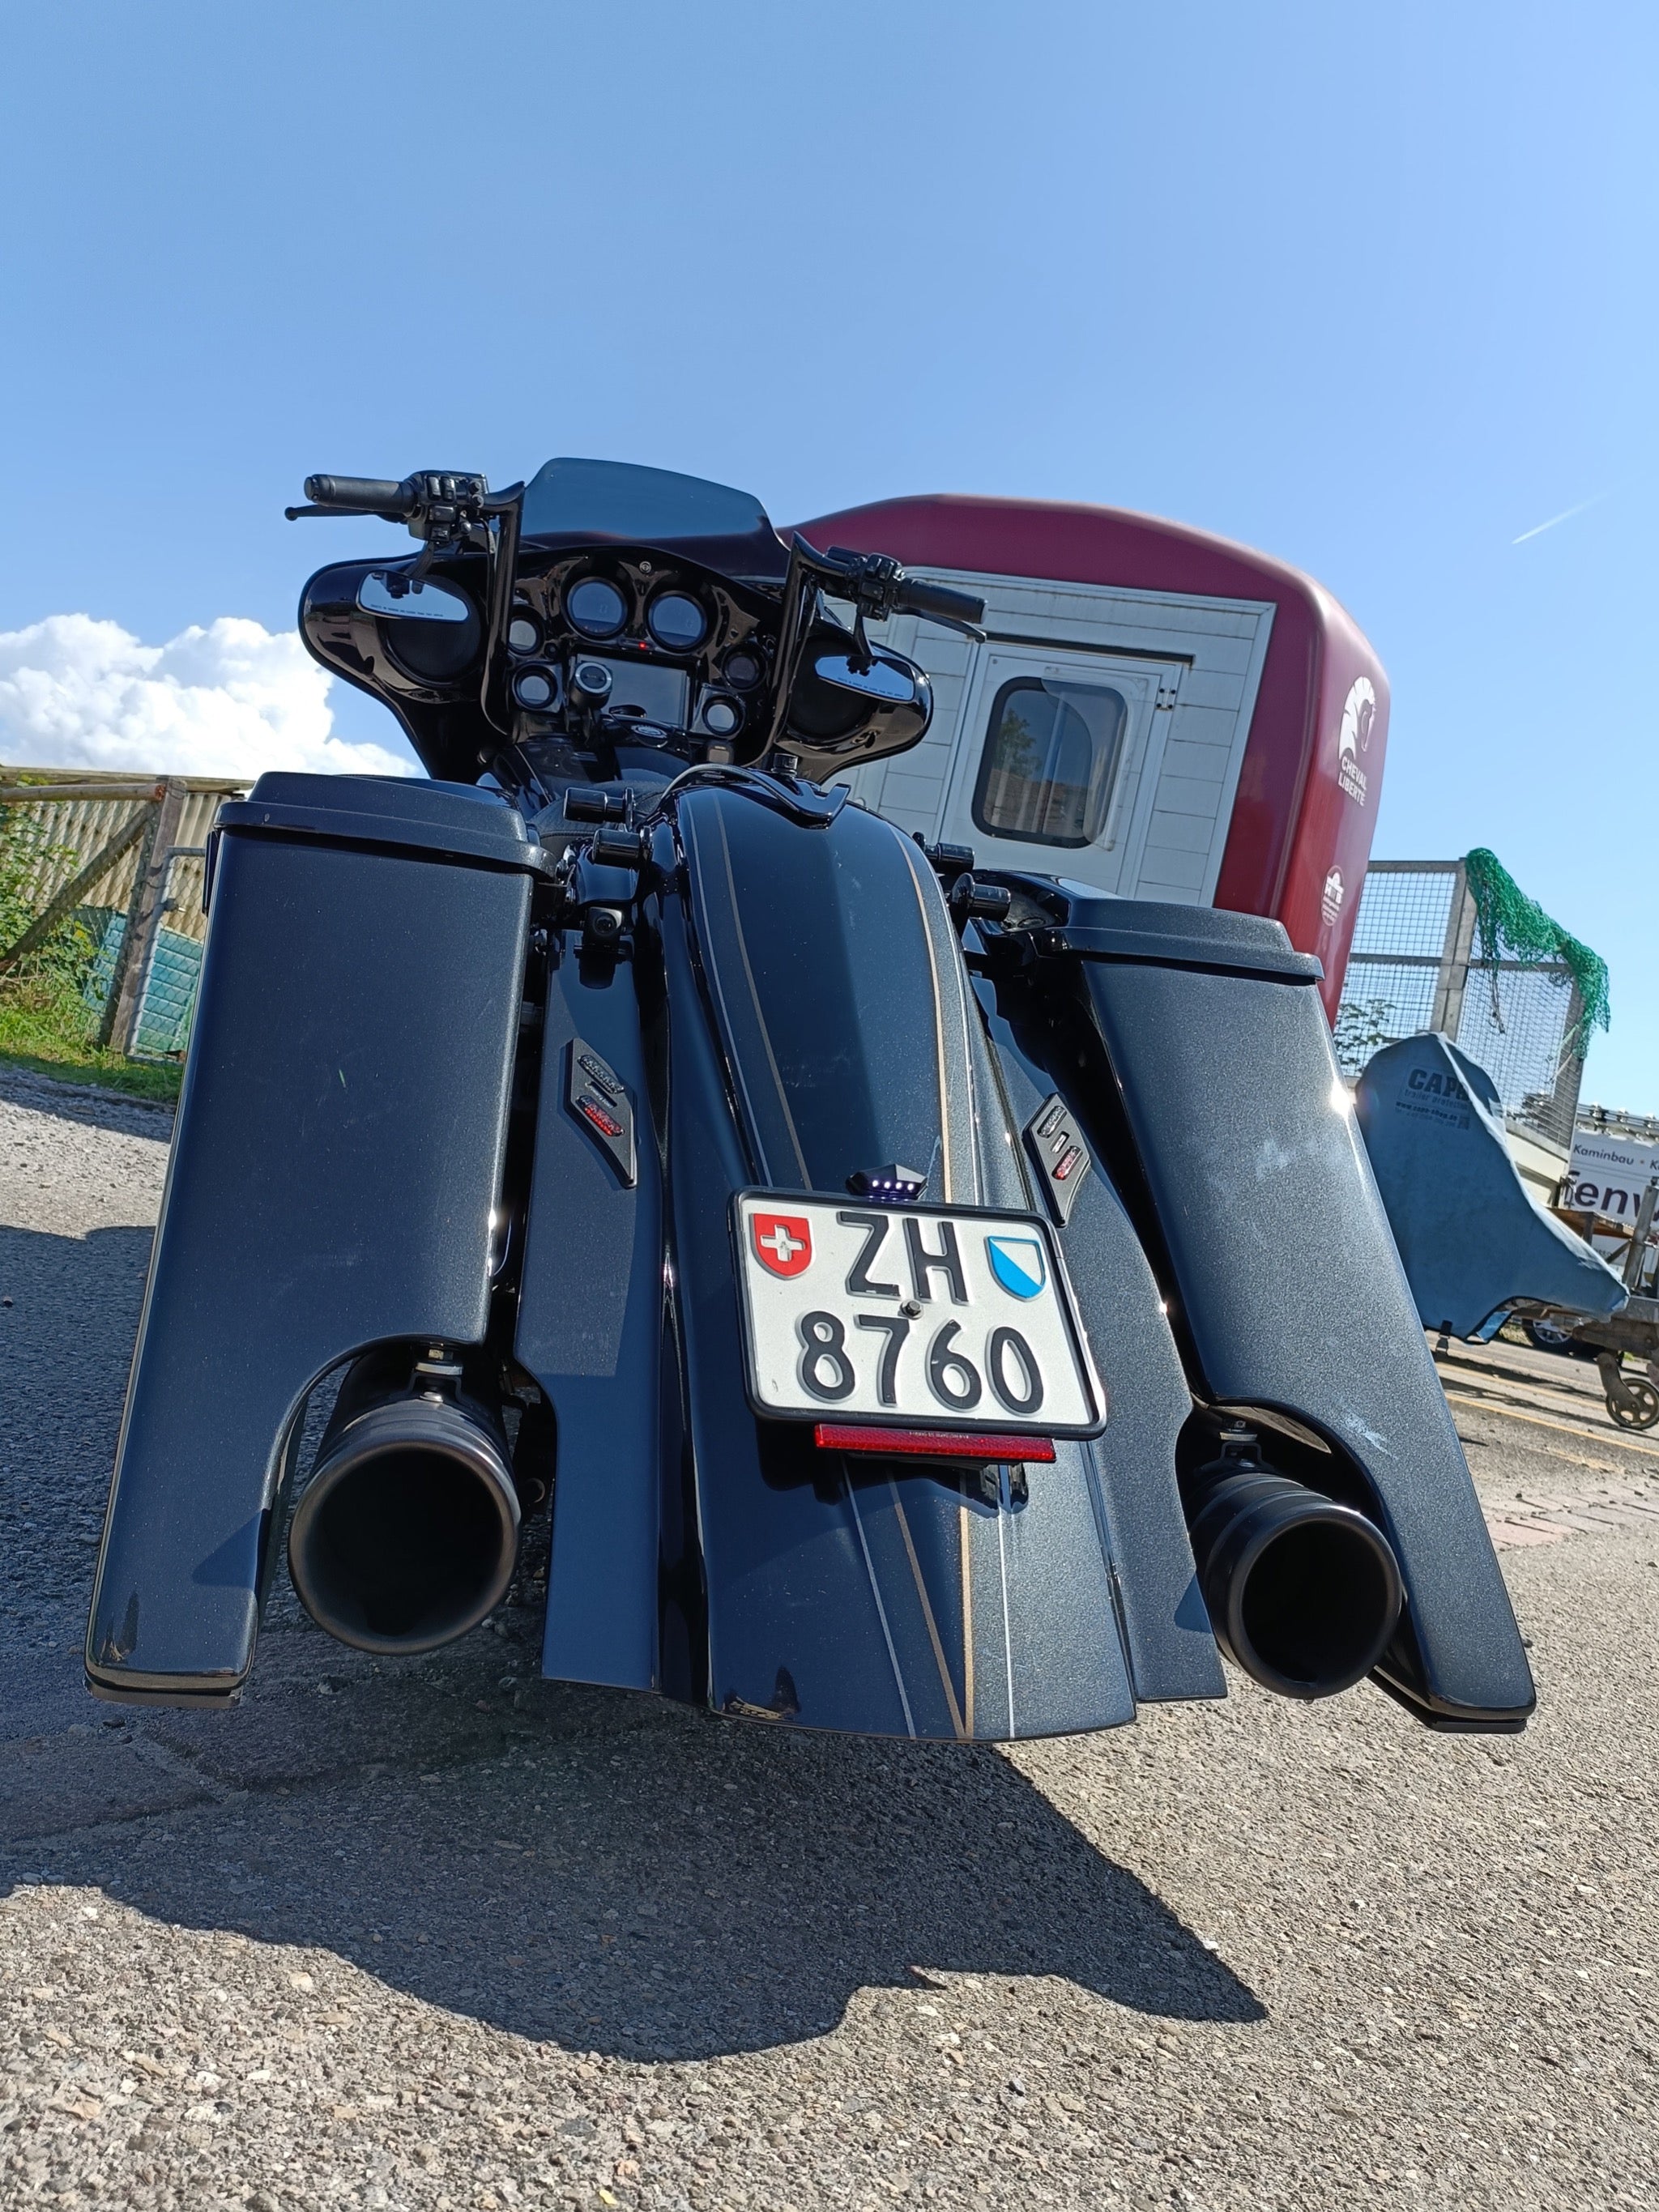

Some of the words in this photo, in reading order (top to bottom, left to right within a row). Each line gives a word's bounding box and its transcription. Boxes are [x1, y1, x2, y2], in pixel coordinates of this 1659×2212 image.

[1341, 755, 1367, 791] CHEVAL
[1572, 1144, 1635, 1166] Kaminbau
[837, 1210, 969, 1304] ZH
[795, 1310, 1045, 1416] 8760
